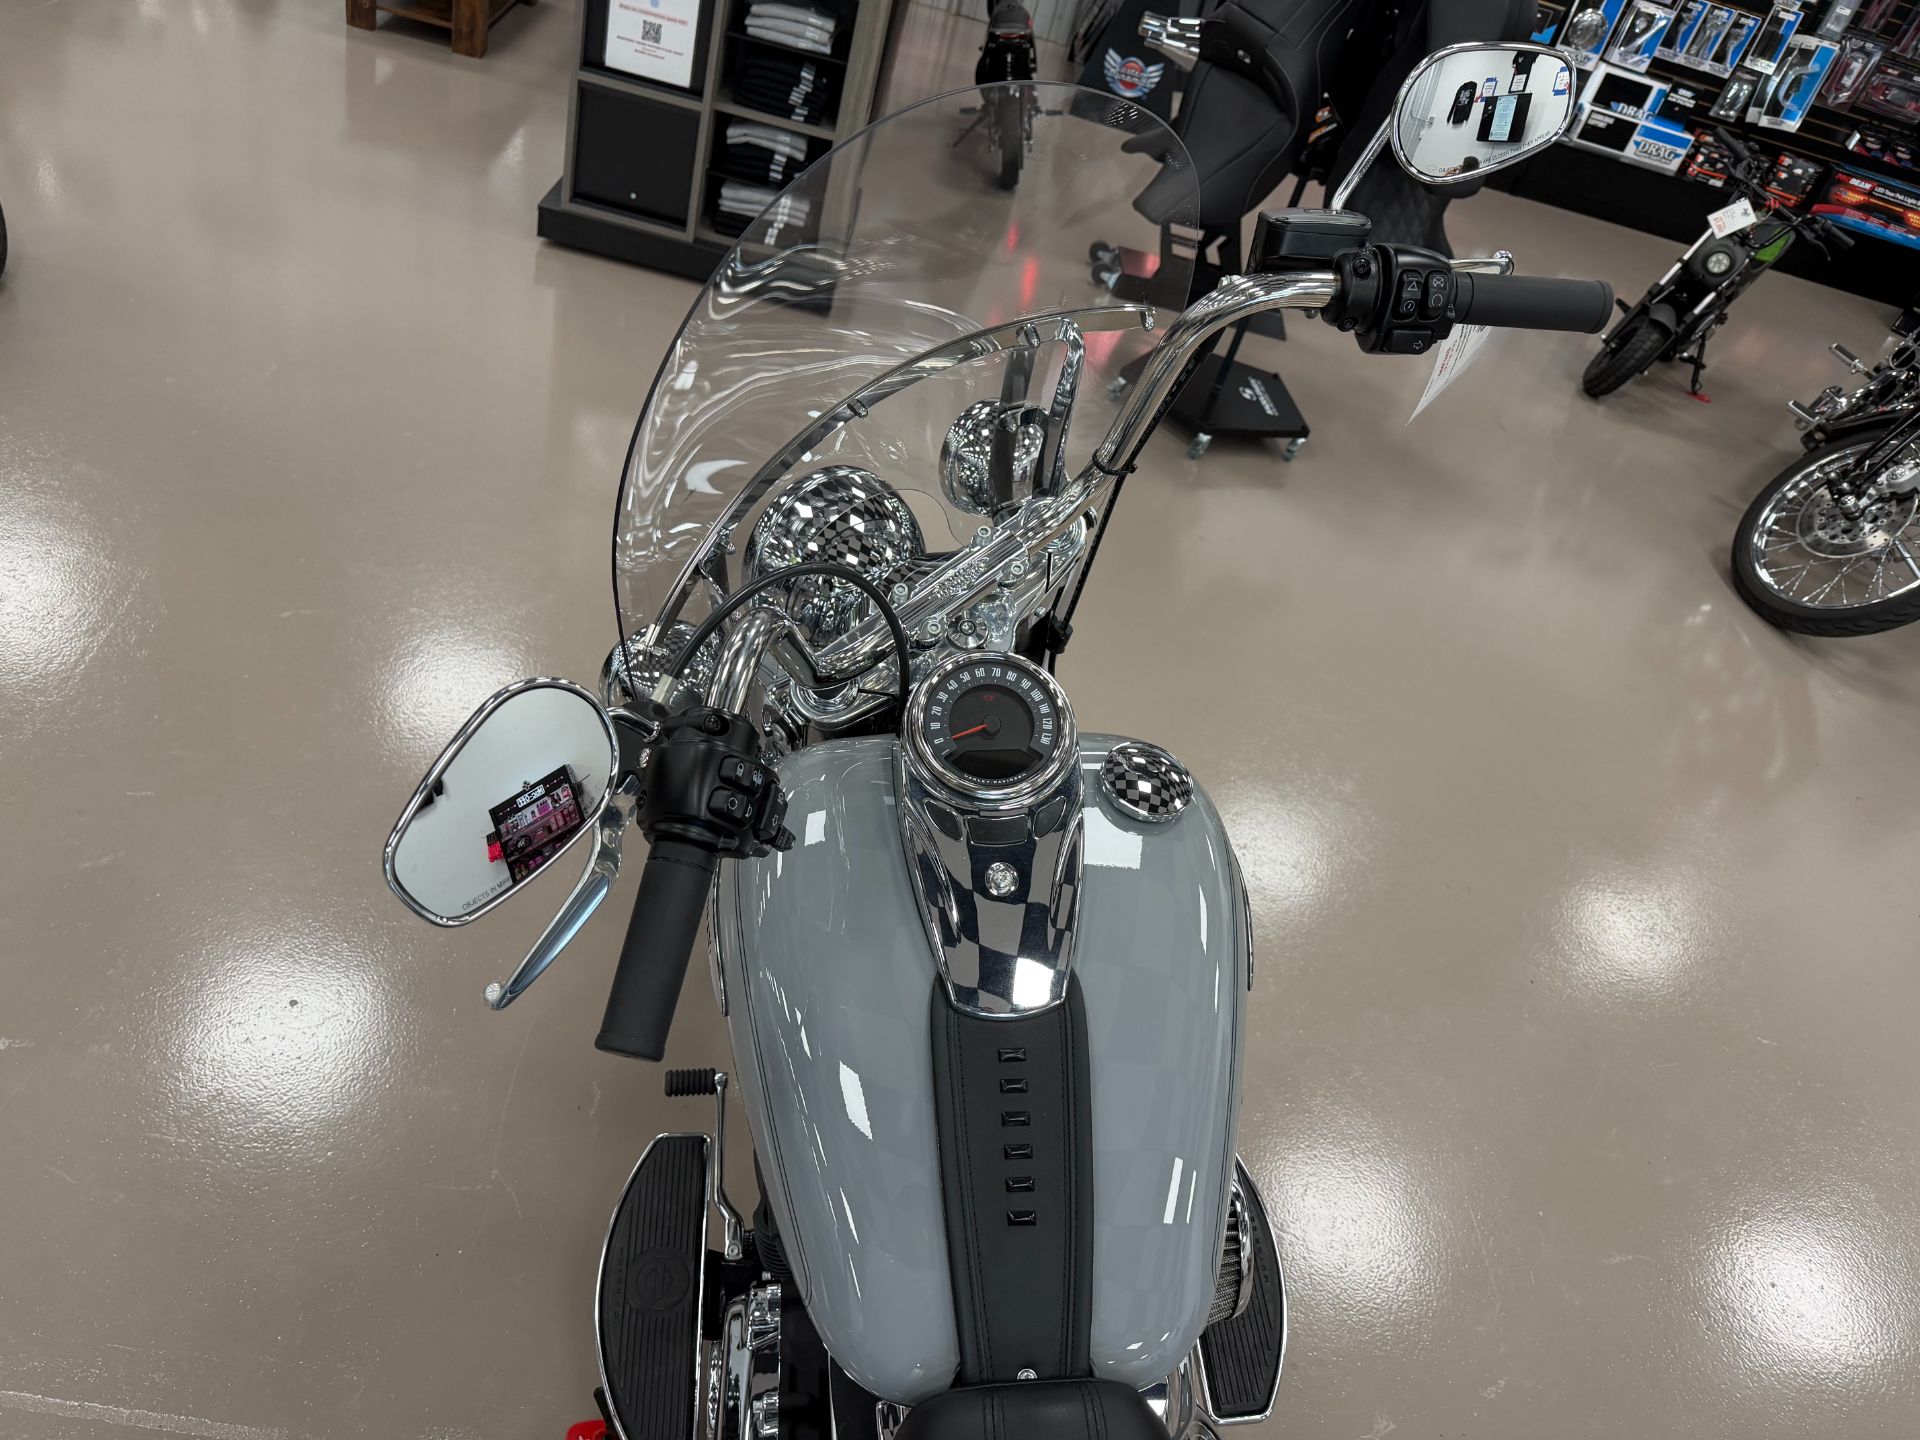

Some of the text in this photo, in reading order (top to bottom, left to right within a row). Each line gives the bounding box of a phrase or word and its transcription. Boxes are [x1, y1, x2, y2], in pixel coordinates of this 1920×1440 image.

[1618, 102, 1654, 121] DRAG
[1638, 139, 1677, 160] DRAG
[960, 671, 971, 683] 50
[975, 667, 985, 678] 60
[991, 667, 1001, 677] 70
[1006, 670, 1017, 682] 80
[946, 679, 958, 691] 40
[1019, 678, 1032, 690] 90
[936, 691, 948, 703] 30
[1030, 688, 1044, 702] 100
[931, 705, 942, 716] 20
[1039, 702, 1050, 714] 110
[930, 722, 941, 730] 10
[1042, 717, 1053, 730] 120
[934, 737, 944, 745] 0
[1040, 732, 1052, 745] 130
[462, 890, 490, 911] OBJECTS
[489, 884, 497, 894] IN
